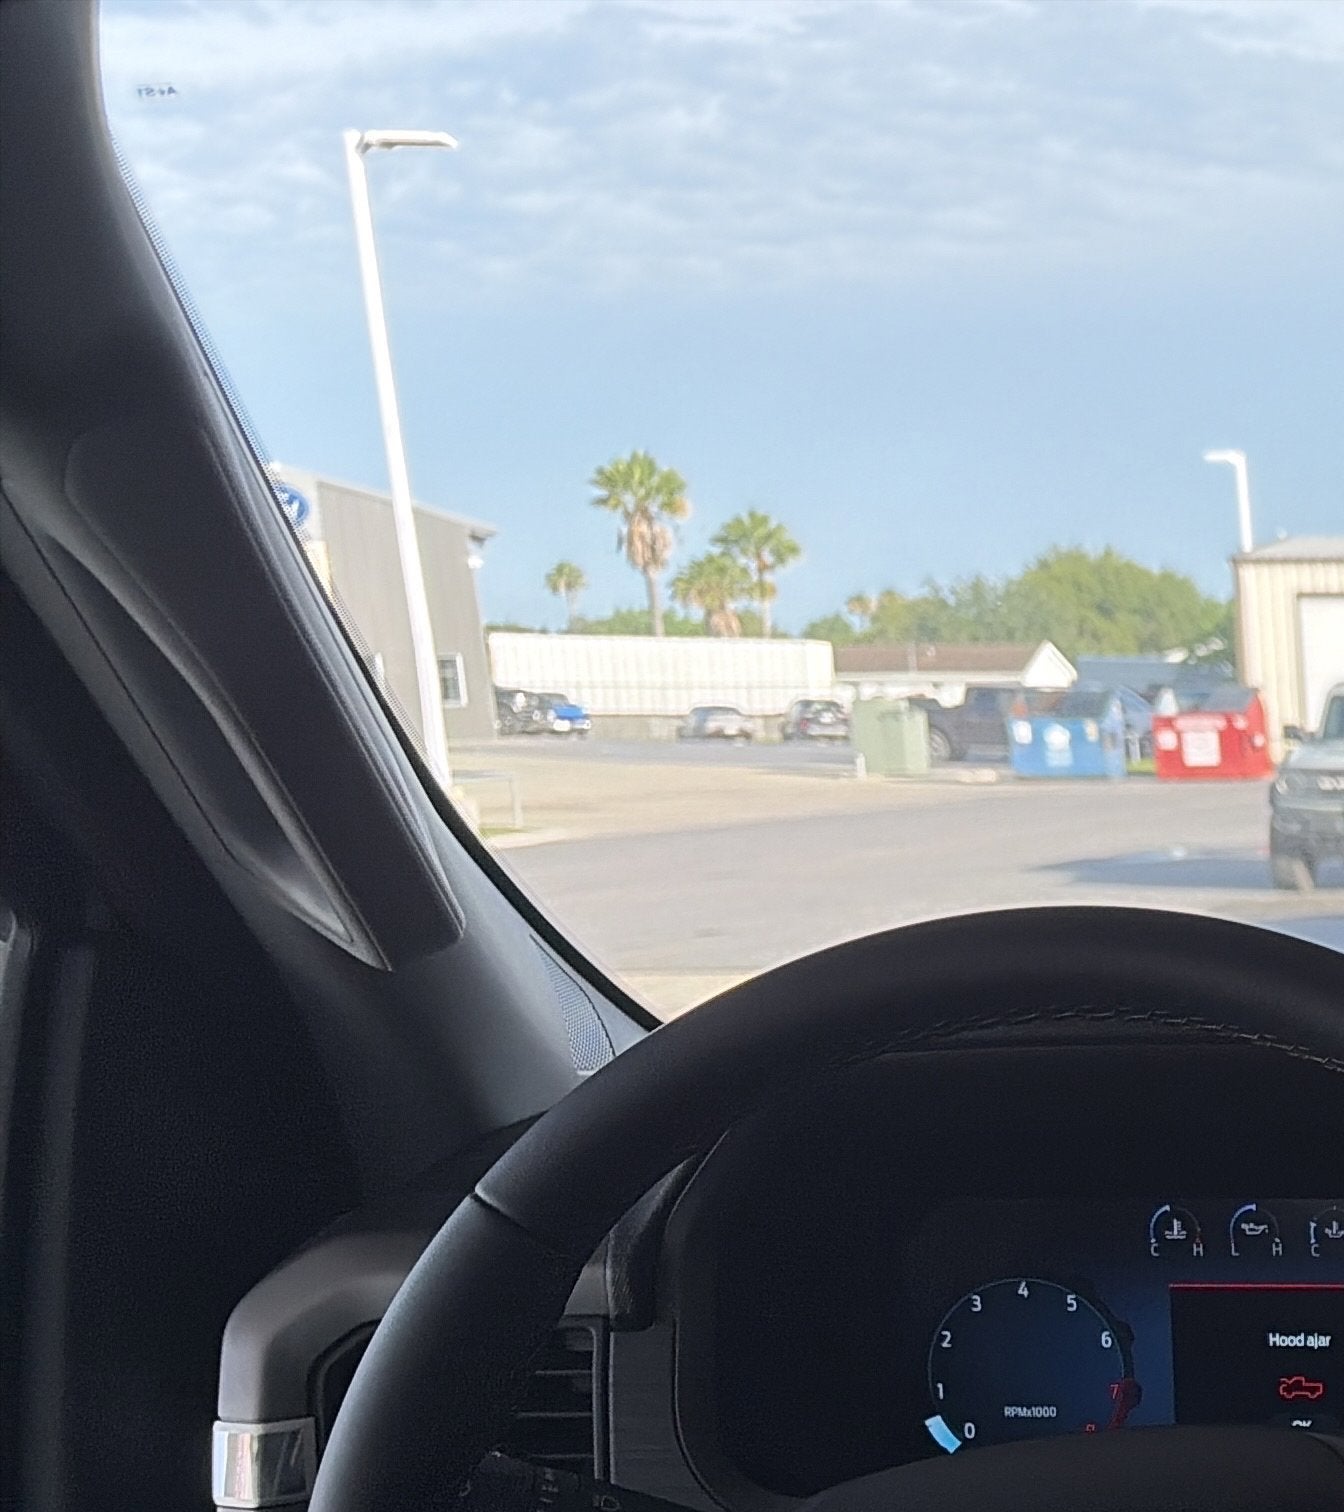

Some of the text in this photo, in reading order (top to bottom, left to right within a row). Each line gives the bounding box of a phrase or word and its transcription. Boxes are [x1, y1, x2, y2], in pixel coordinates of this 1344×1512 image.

[1151, 1244, 1159, 1256] C
[1193, 1244, 1204, 1257] H
[1231, 1244, 1240, 1257] L
[1272, 1244, 1282, 1257] H
[1311, 1244, 1320, 1257] C
[1018, 1281, 1029, 1298] 4
[971, 1295, 982, 1312] 3
[1066, 1295, 1077, 1312] 5
[941, 1331, 952, 1348] 2
[1101, 1331, 1112, 1348] 6
[1268, 1332, 1331, 1350] Hood ajar
[936, 1382, 945, 1399] 1
[1110, 1383, 1119, 1400] 7
[1004, 1406, 1057, 1418] RPMx1000
[964, 1422, 975, 1438] 0
